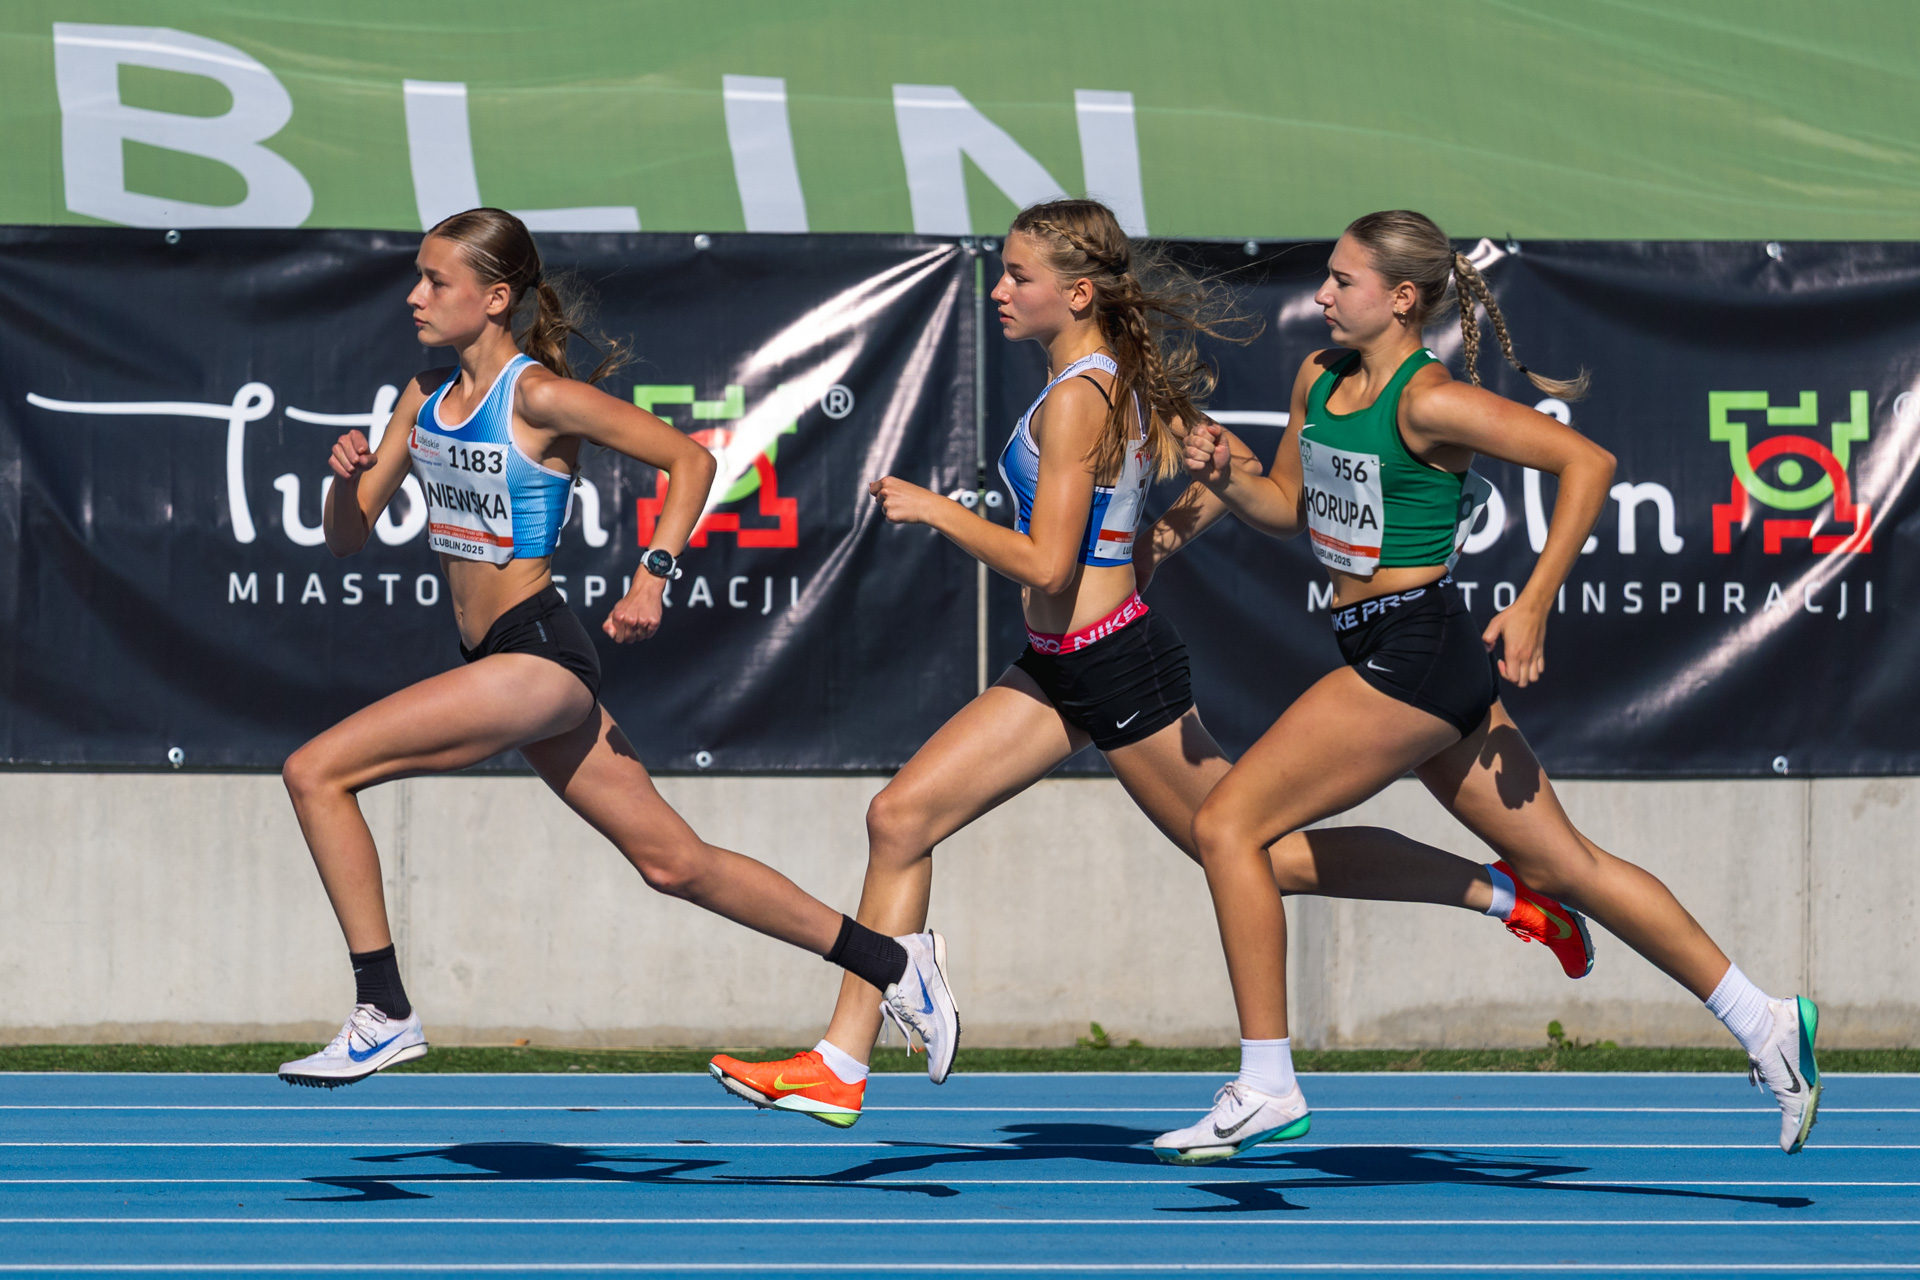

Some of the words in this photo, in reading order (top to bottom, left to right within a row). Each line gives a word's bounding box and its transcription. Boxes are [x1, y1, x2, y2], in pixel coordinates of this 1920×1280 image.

[448, 445, 503, 474] 1183
[1331, 455, 1368, 483] 956
[427, 481, 508, 520] NIEWSKA
[1304, 486, 1378, 530] KORUPA
[434, 537, 461, 551] LUBLIN
[461, 543, 484, 555] 2025
[1334, 554, 1351, 567] 2025
[228, 573, 439, 606] MIASTO
[1307, 581, 1517, 614] MTO
[1557, 580, 1873, 621] INSPIRACJI
[1361, 588, 1426, 622] PRO
[1074, 603, 1137, 651] NIKE
